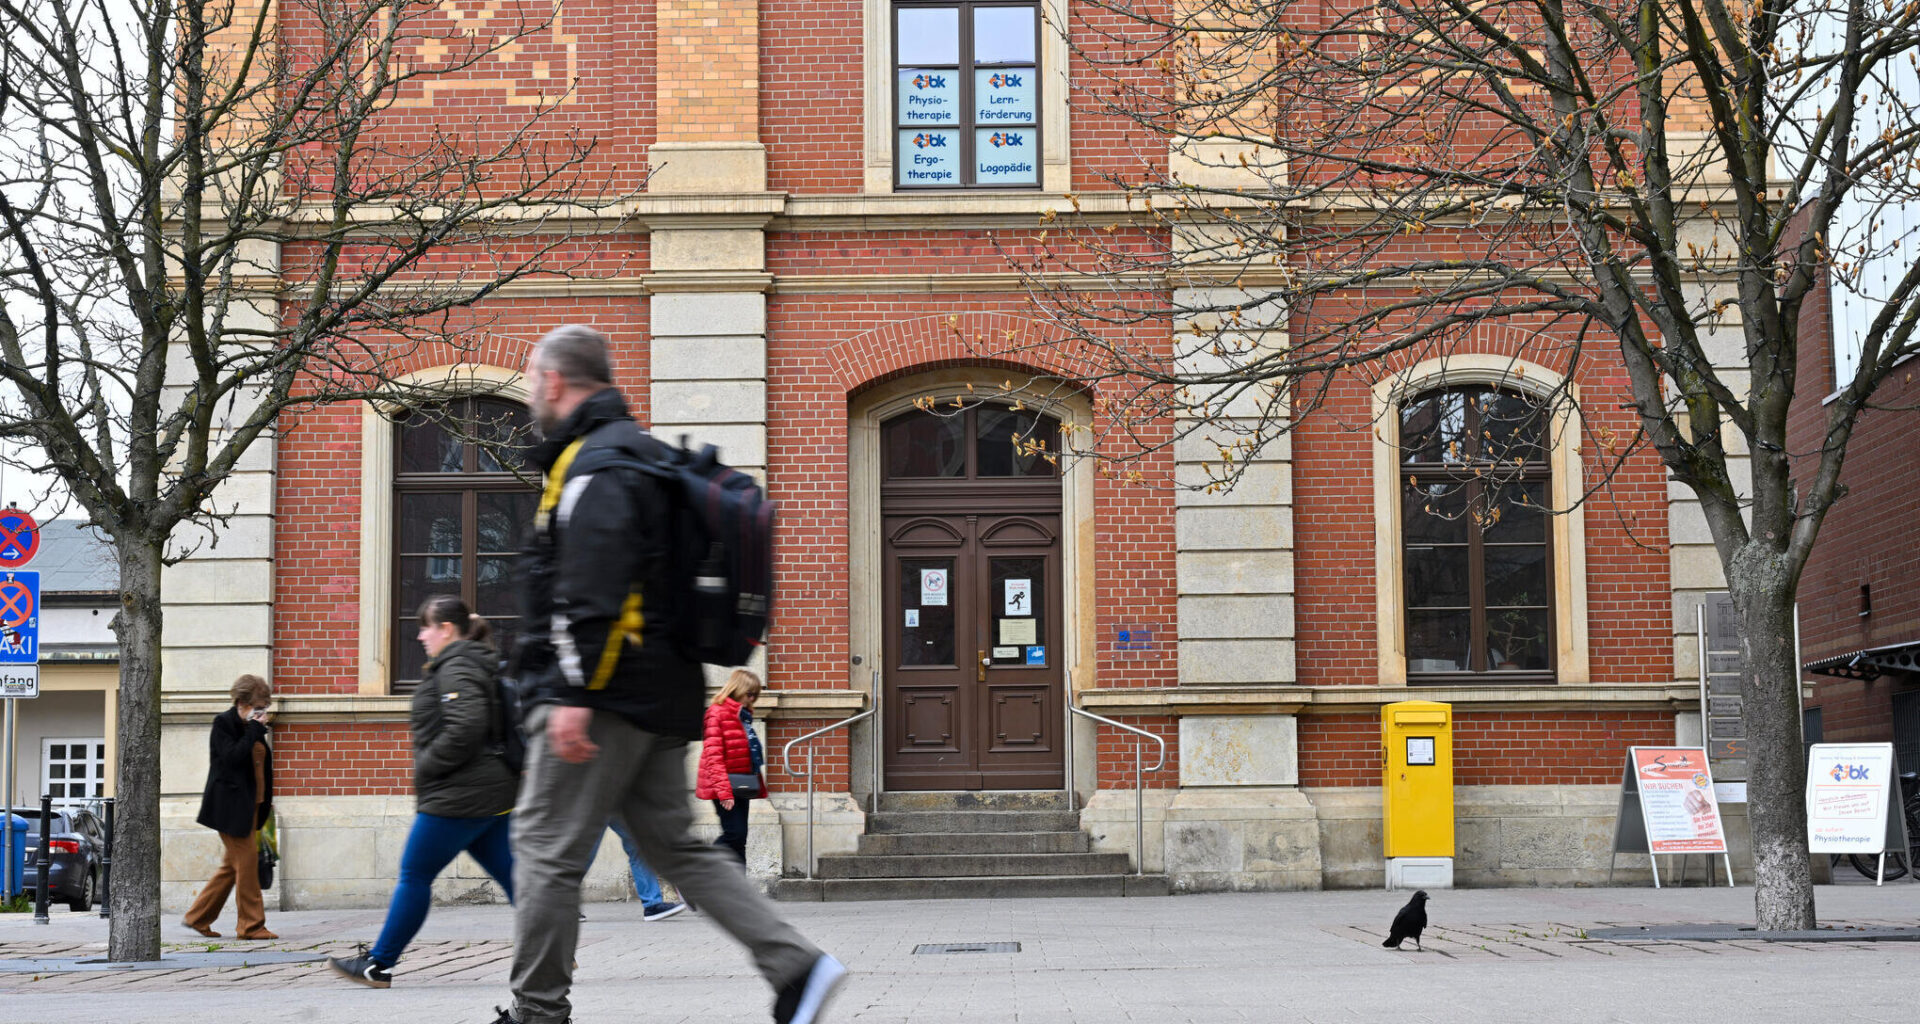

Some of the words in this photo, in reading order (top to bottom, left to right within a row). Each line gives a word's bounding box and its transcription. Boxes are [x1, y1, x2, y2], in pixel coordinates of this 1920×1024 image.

[909, 95, 948, 107] Physio-
[990, 95, 1020, 105] Lern-
[907, 110, 951, 122] therapie
[980, 109, 1032, 121] förderung
[914, 154, 944, 166] Ergo-
[908, 169, 952, 181] therapie
[980, 163, 1032, 175] Logopädie
[0, 675, 34, 689] fang
[1814, 834, 1871, 844] Physiotherapie
